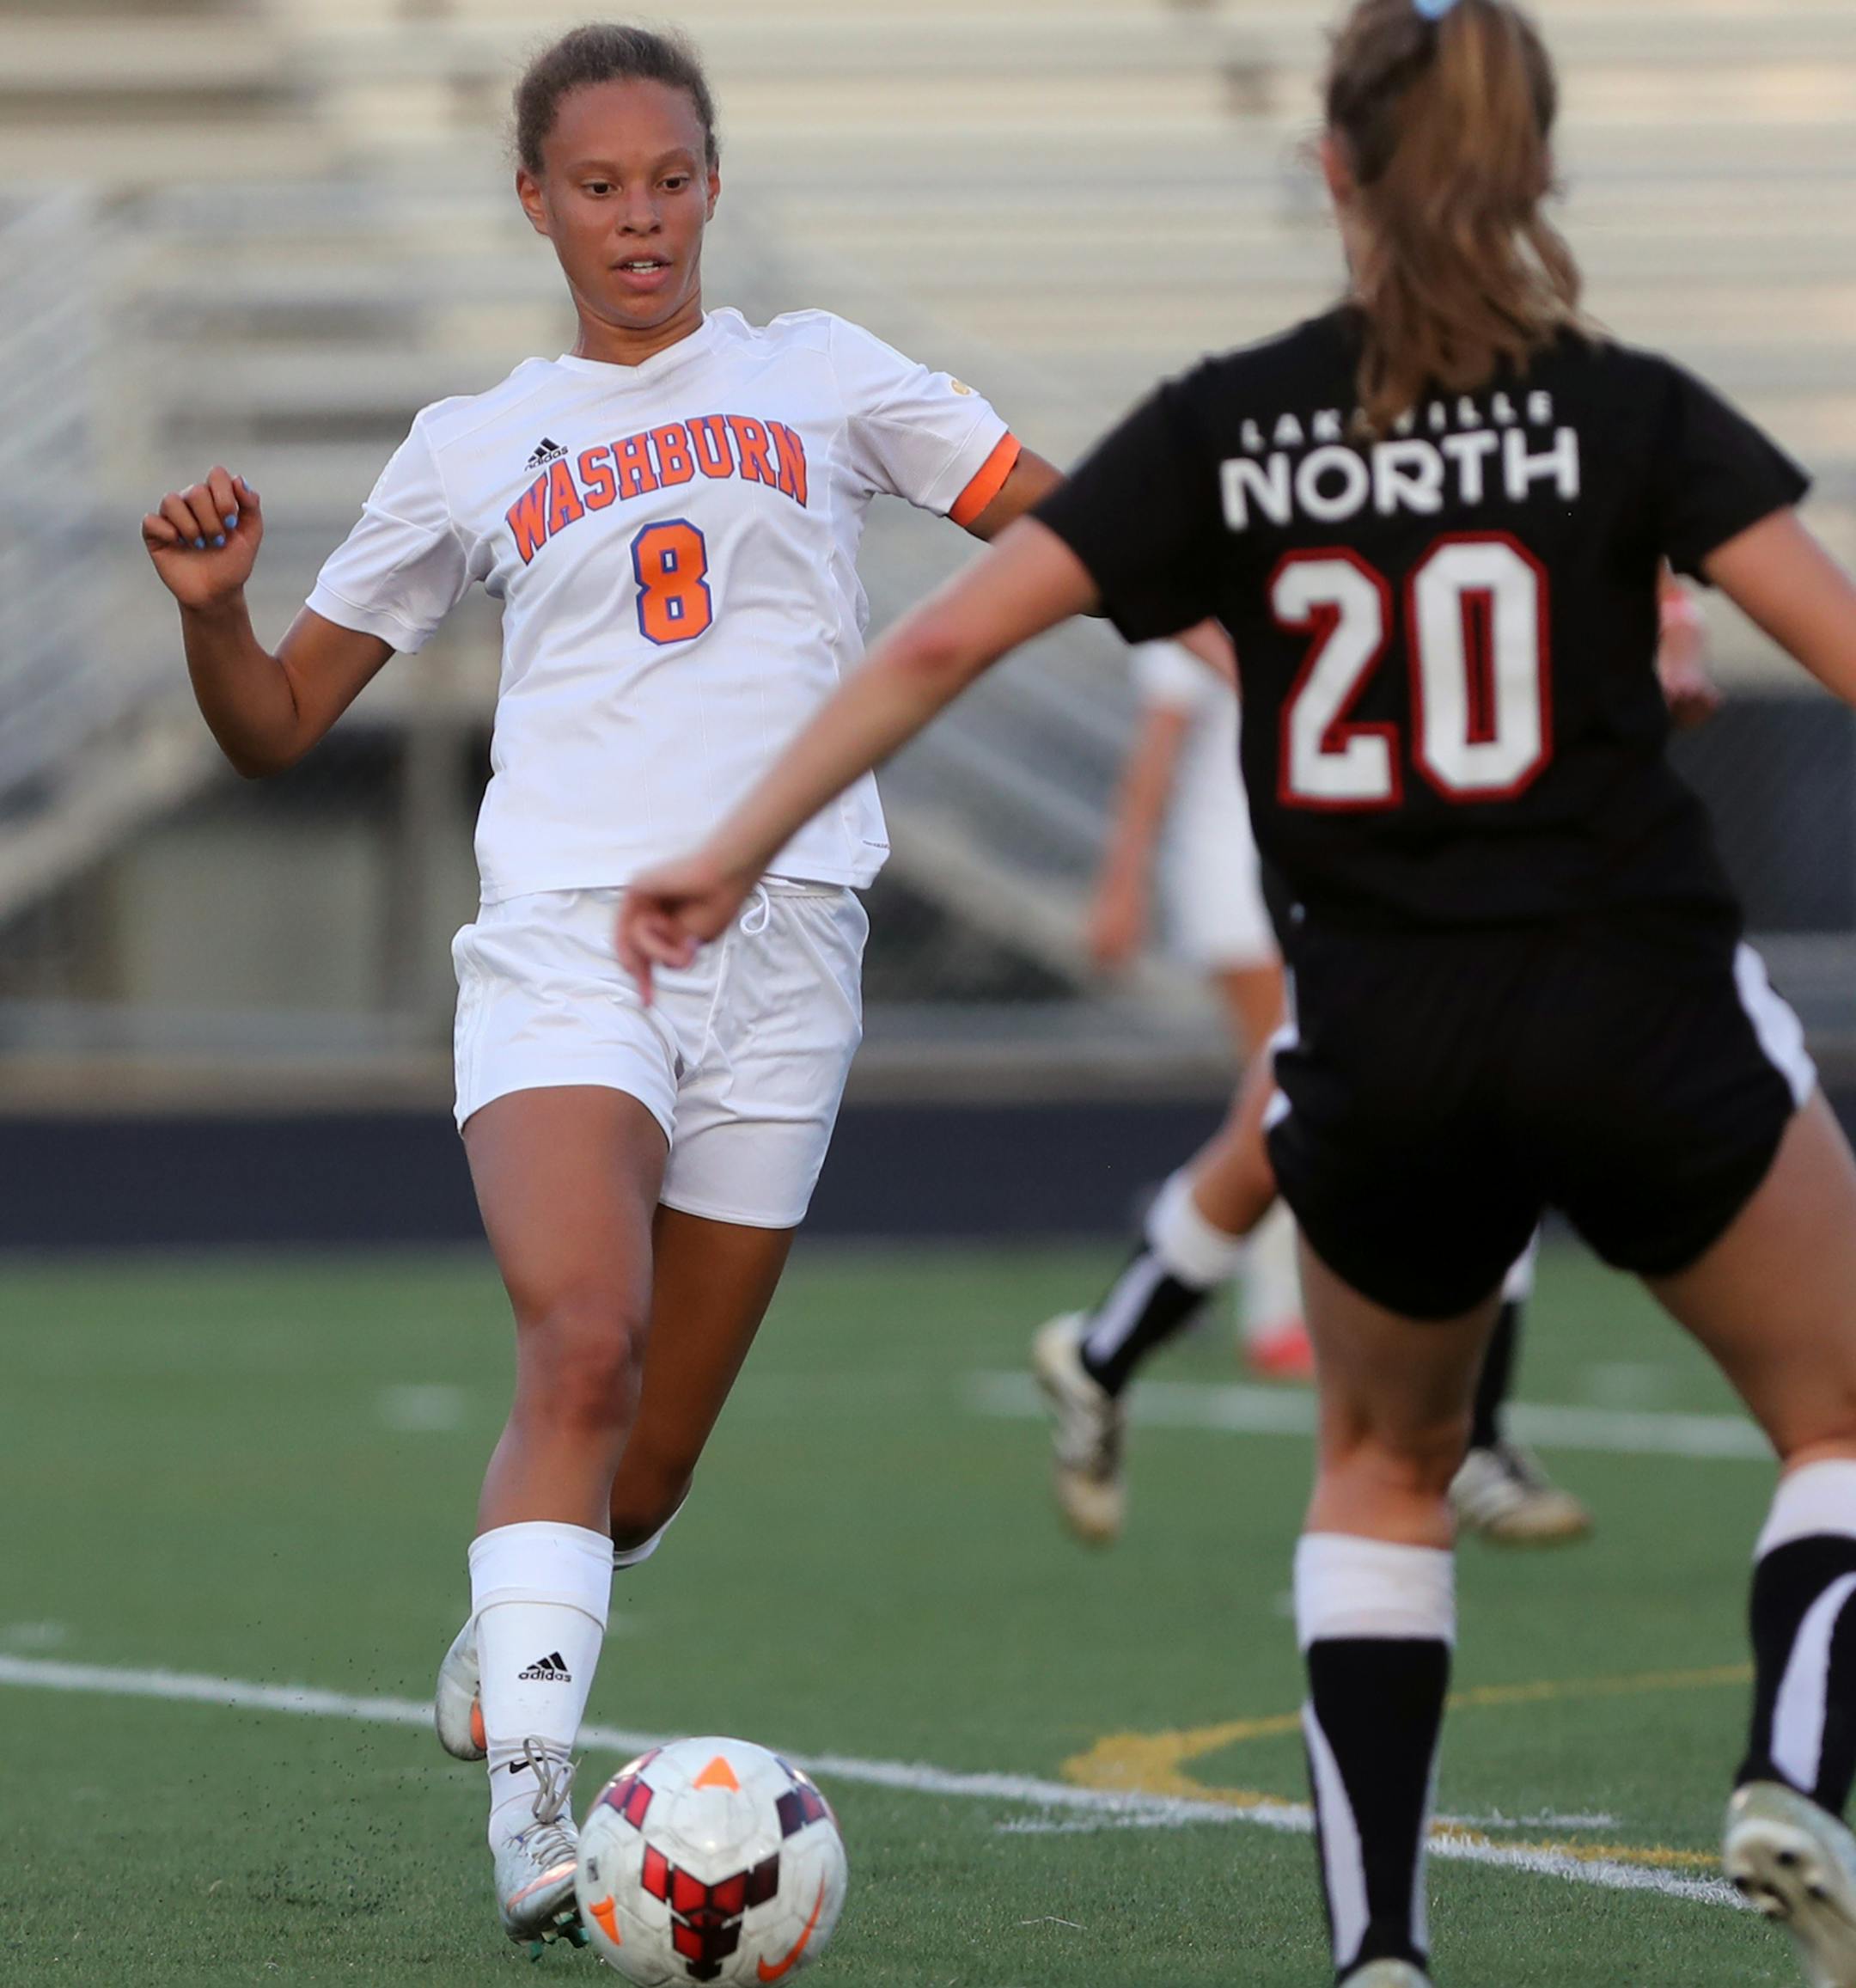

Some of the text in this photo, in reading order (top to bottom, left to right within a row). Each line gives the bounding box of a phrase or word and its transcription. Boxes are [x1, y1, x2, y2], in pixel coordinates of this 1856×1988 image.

[504, 413, 808, 566] WASHBURN
[523, 445, 569, 472] adidas
[1219, 426, 1580, 531] NORTH
[630, 517, 713, 646] 8
[1267, 529, 1554, 813] 20
[518, 1667, 572, 1682] adidas
